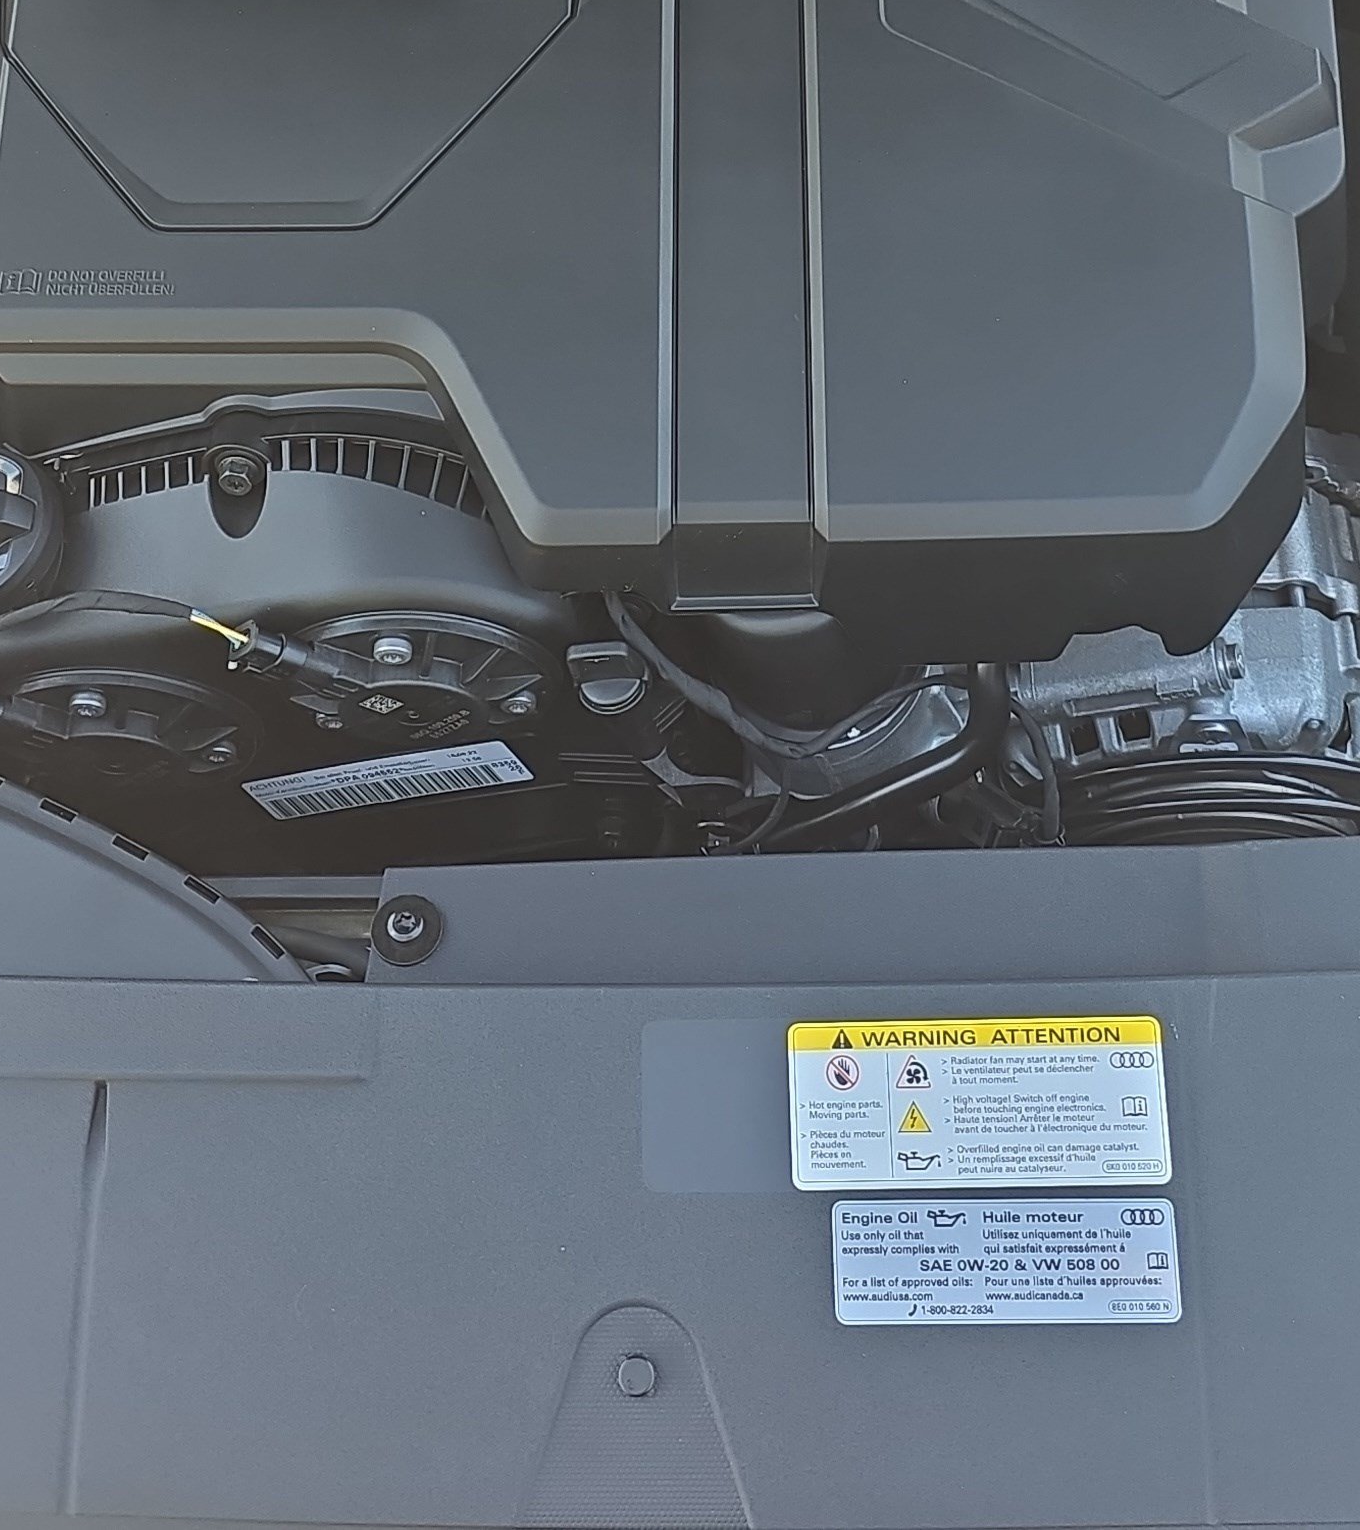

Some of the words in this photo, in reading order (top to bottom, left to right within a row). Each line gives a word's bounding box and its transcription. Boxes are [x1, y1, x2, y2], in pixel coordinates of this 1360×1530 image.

[48, 269, 67, 282] DO
[70, 269, 94, 282] NOT
[46, 282, 86, 296] NICHT
[249, 775, 306, 792] ACHTUNG!
[861, 1029, 976, 1046] WARNING
[991, 1027, 1120, 1044] ATTENTION
[951, 1057, 987, 1065] Radiator
[990, 1056, 1004, 1064] fan
[1006, 1056, 1024, 1065] may
[1027, 1055, 1047, 1063] start
[1059, 1056, 1075, 1064] any
[1078, 1054, 1100, 1062] time.
[964, 1066, 1009, 1074] ventilateur
[1012, 1066, 1032, 1075] peut
[960, 1076, 977, 1084] tout
[953, 1096, 974, 1106] High
[1013, 1094, 1043, 1102] Switch
[1045, 1094, 1057, 1102] off
[1059, 1095, 1089, 1103] engine
[809, 1101, 824, 1109] Hot
[826, 1102, 856, 1112] engine
[859, 1101, 883, 1110] parts.
[984, 1104, 1022, 1114] touching
[1025, 1105, 1055, 1113] engine
[1057, 1104, 1106, 1112] electronics.
[809, 1111, 842, 1120] Moving
[844, 1111, 869, 1120] parts.
[1020, 1114, 1050, 1122] Arrêter
[1053, 1114, 1061, 1122] le
[1063, 1114, 1095, 1122] moteur
[994, 1125, 1028, 1133] toucher
[1100, 1123, 1111, 1131] du
[1113, 1123, 1148, 1131] moteur.
[1002, 1144, 1032, 1154] engine
[1034, 1144, 1045, 1152] oil
[1065, 1143, 1101, 1153] damage
[1103, 1142, 1139, 1152] catalyst.
[973, 1155, 1026, 1164] remplissage
[1029, 1154, 1063, 1162] excessif
[958, 1166, 978, 1174] peut
[980, 1165, 1002, 1173] nuire
[1018, 1164, 1066, 1173] catalyseur.
[842, 1212, 892, 1226] Engine
[898, 1212, 917, 1223] Oil
[983, 1211, 1020, 1223] Huile
[1026, 1212, 1084, 1223] moteur
[842, 1231, 861, 1240] Use
[864, 1230, 885, 1242] only
[889, 1230, 901, 1239] oil
[904, 1231, 924, 1239] that
[983, 1229, 1019, 1239] Utilisez
[1022, 1229, 1083, 1240] uniquement
[1085, 1230, 1097, 1238] de
[842, 1245, 888, 1256] expressly
[891, 1245, 935, 1256] complies
[938, 1244, 959, 1253] with
[984, 1243, 1000, 1255] qui
[1003, 1243, 1042, 1253] satisfait
[1045, 1243, 1116, 1254] expressément
[920, 1260, 952, 1271] SAE
[957, 1260, 1008, 1271] 0W-20
[1015, 1259, 1027, 1271] &
[1032, 1259, 1061, 1270] VW
[1067, 1259, 1095, 1270] 508
[1101, 1259, 1120, 1270] 00
[843, 1278, 858, 1287] For
[871, 1277, 885, 1286] list
[888, 1277, 898, 1286] of
[902, 1277, 948, 1289] approved
[952, 1277, 973, 1286] oils:
[985, 1277, 1008, 1286] Pour
[1033, 1277, 1054, 1285] liste
[1100, 1276, 1162, 1287] approuvées:
[843, 1292, 933, 1301] www.audiusa.com
[985, 1291, 1083, 1300] www.audicanada.ca
[922, 1305, 993, 1314] 1-800-822-2834
[1129, 1303, 1143, 1311] 010
